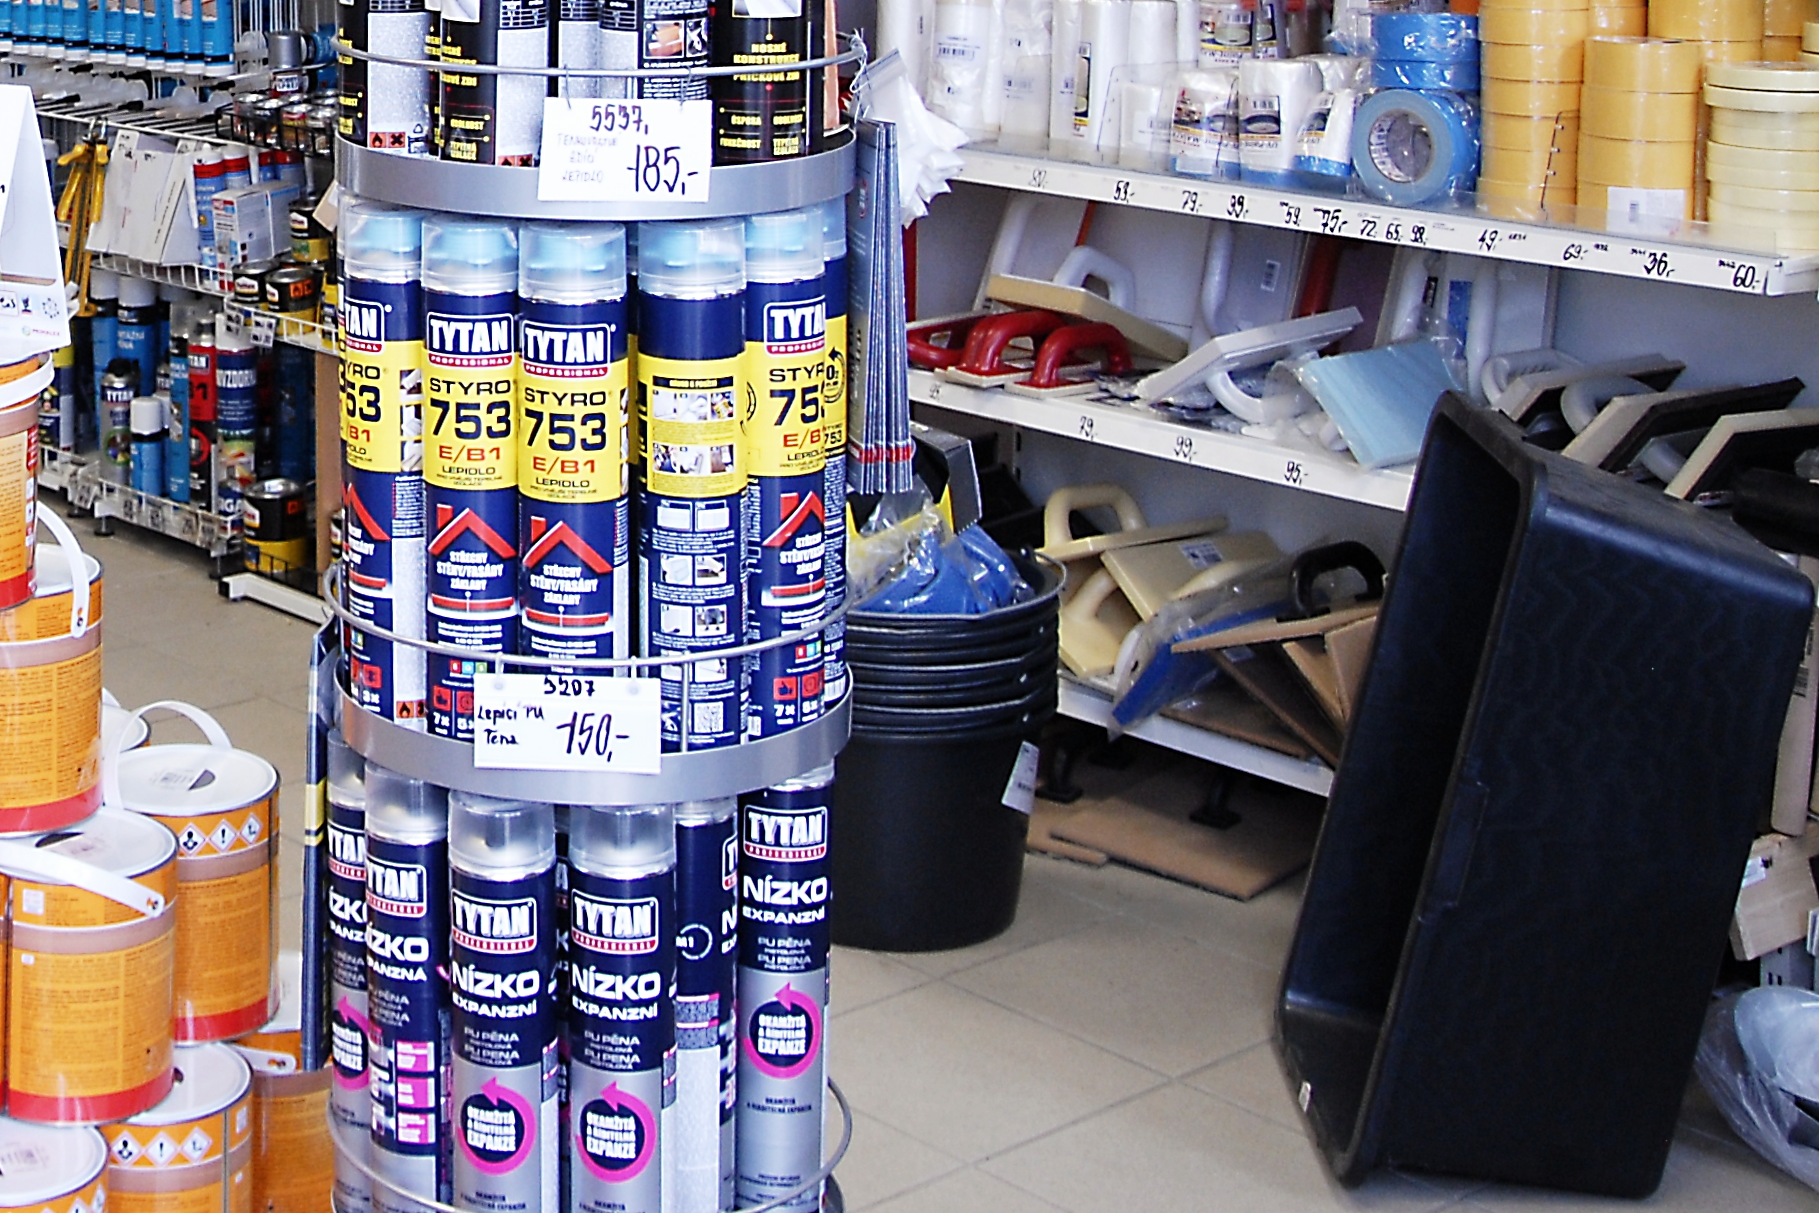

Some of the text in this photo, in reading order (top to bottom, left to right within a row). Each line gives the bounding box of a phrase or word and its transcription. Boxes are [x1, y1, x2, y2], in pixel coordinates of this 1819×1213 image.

[627, 145, 698, 195] 185,-
[1733, 265, 1760, 289] 60,-
[431, 319, 508, 353] TYTAN
[770, 308, 825, 340] TYTA
[525, 328, 605, 364] TYTAN
[430, 379, 511, 396] STYRO
[524, 388, 606, 406] STYRO
[431, 399, 511, 440] 753
[525, 409, 607, 452] 753
[439, 445, 501, 463] E/B1
[533, 456, 596, 474] E/B1
[442, 466, 496, 476] LEPIDLO
[535, 477, 590, 488] LEPIDLO
[557, 711, 630, 763] 150,-
[748, 811, 823, 846] TYTAN
[743, 875, 827, 905] NÍZKO
[453, 897, 531, 938] TYTAN
[574, 897, 652, 938] TYTAN
[742, 905, 825, 925] EXPANZNÍ
[758, 936, 811, 949] PU PĚNA
[452, 960, 540, 999] NÍZKO
[572, 962, 661, 1000] NÍZKO
[452, 991, 537, 1019] EXPANZNÍ
[572, 995, 658, 1021] EXPANZNÍ
[465, 1026, 519, 1043] PU PĚNA
[584, 1030, 640, 1046] PU PĚNA
